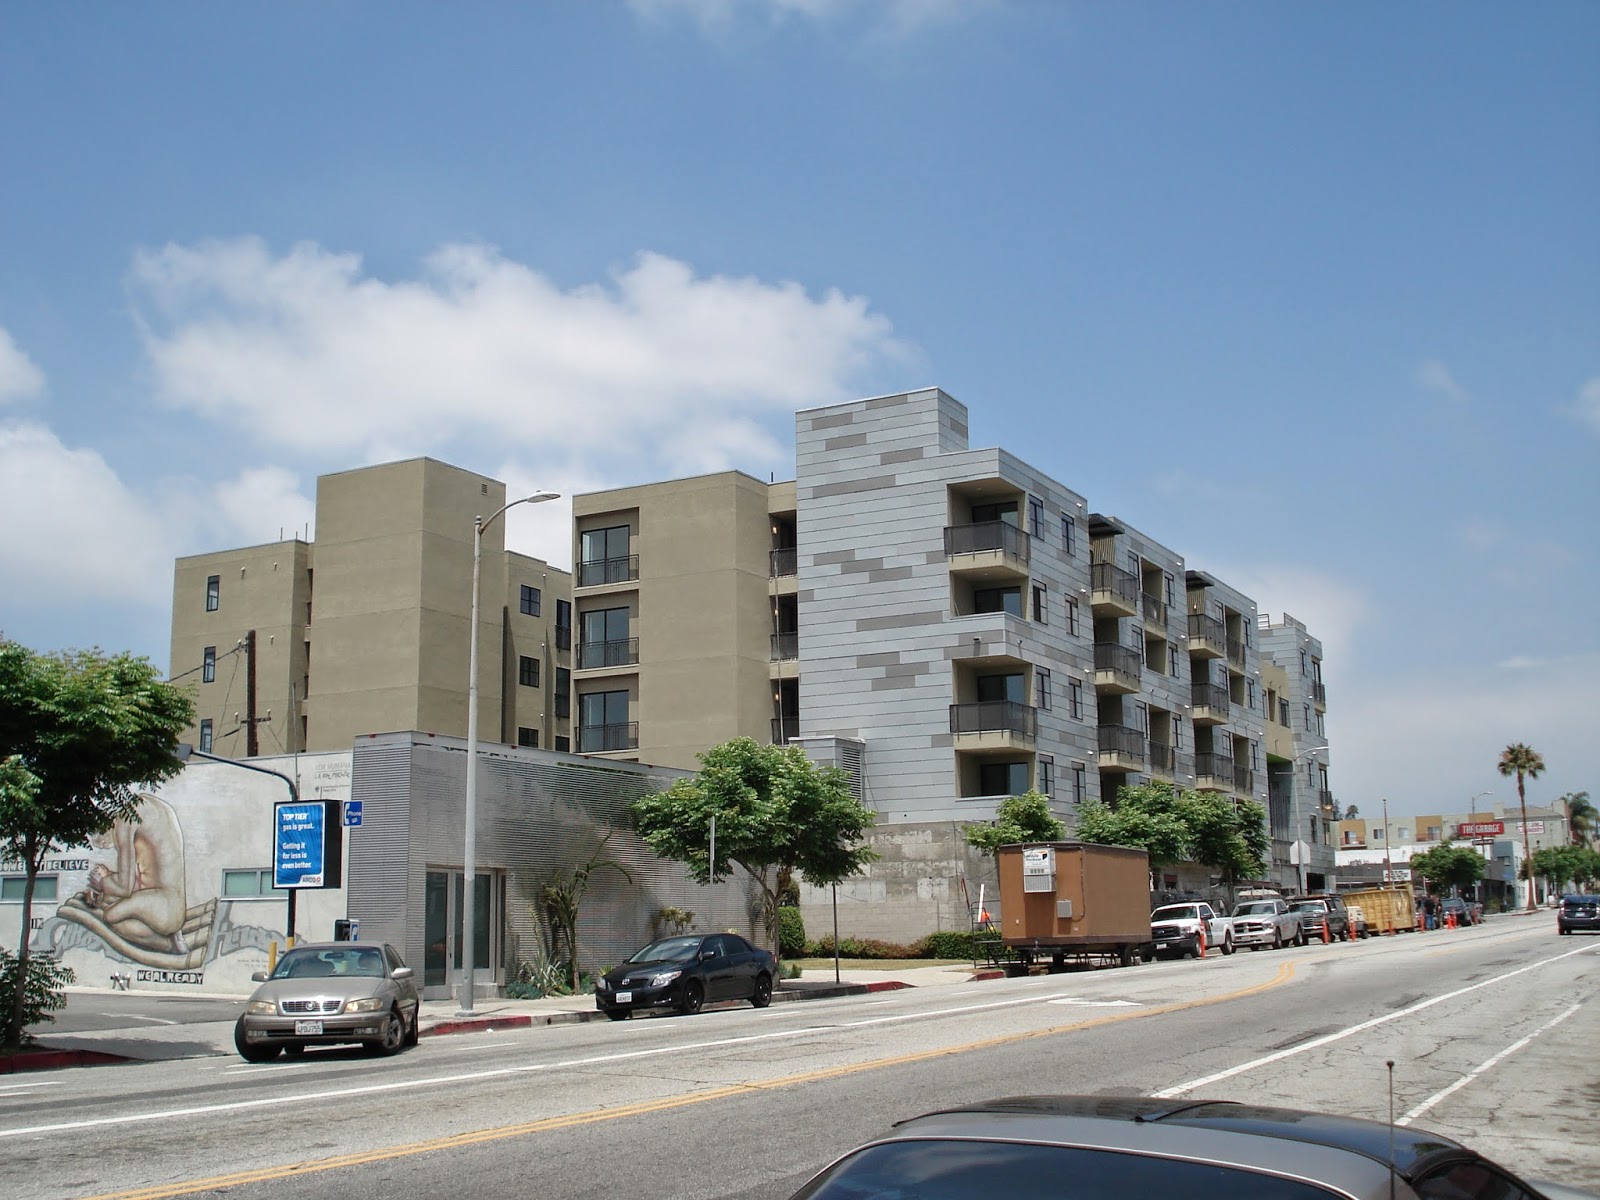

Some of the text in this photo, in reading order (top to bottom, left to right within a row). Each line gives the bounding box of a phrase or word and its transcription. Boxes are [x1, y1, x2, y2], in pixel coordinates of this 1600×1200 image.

[295, 812, 308, 820] TIER
[297, 822, 315, 831] great.
[1463, 823, 1501, 834] THE GARAGE
[282, 841, 306, 851] Getting it
[9, 861, 24, 871] WE
[46, 859, 89, 871] BELIEVE
[137, 970, 203, 984] WE ALREADY
